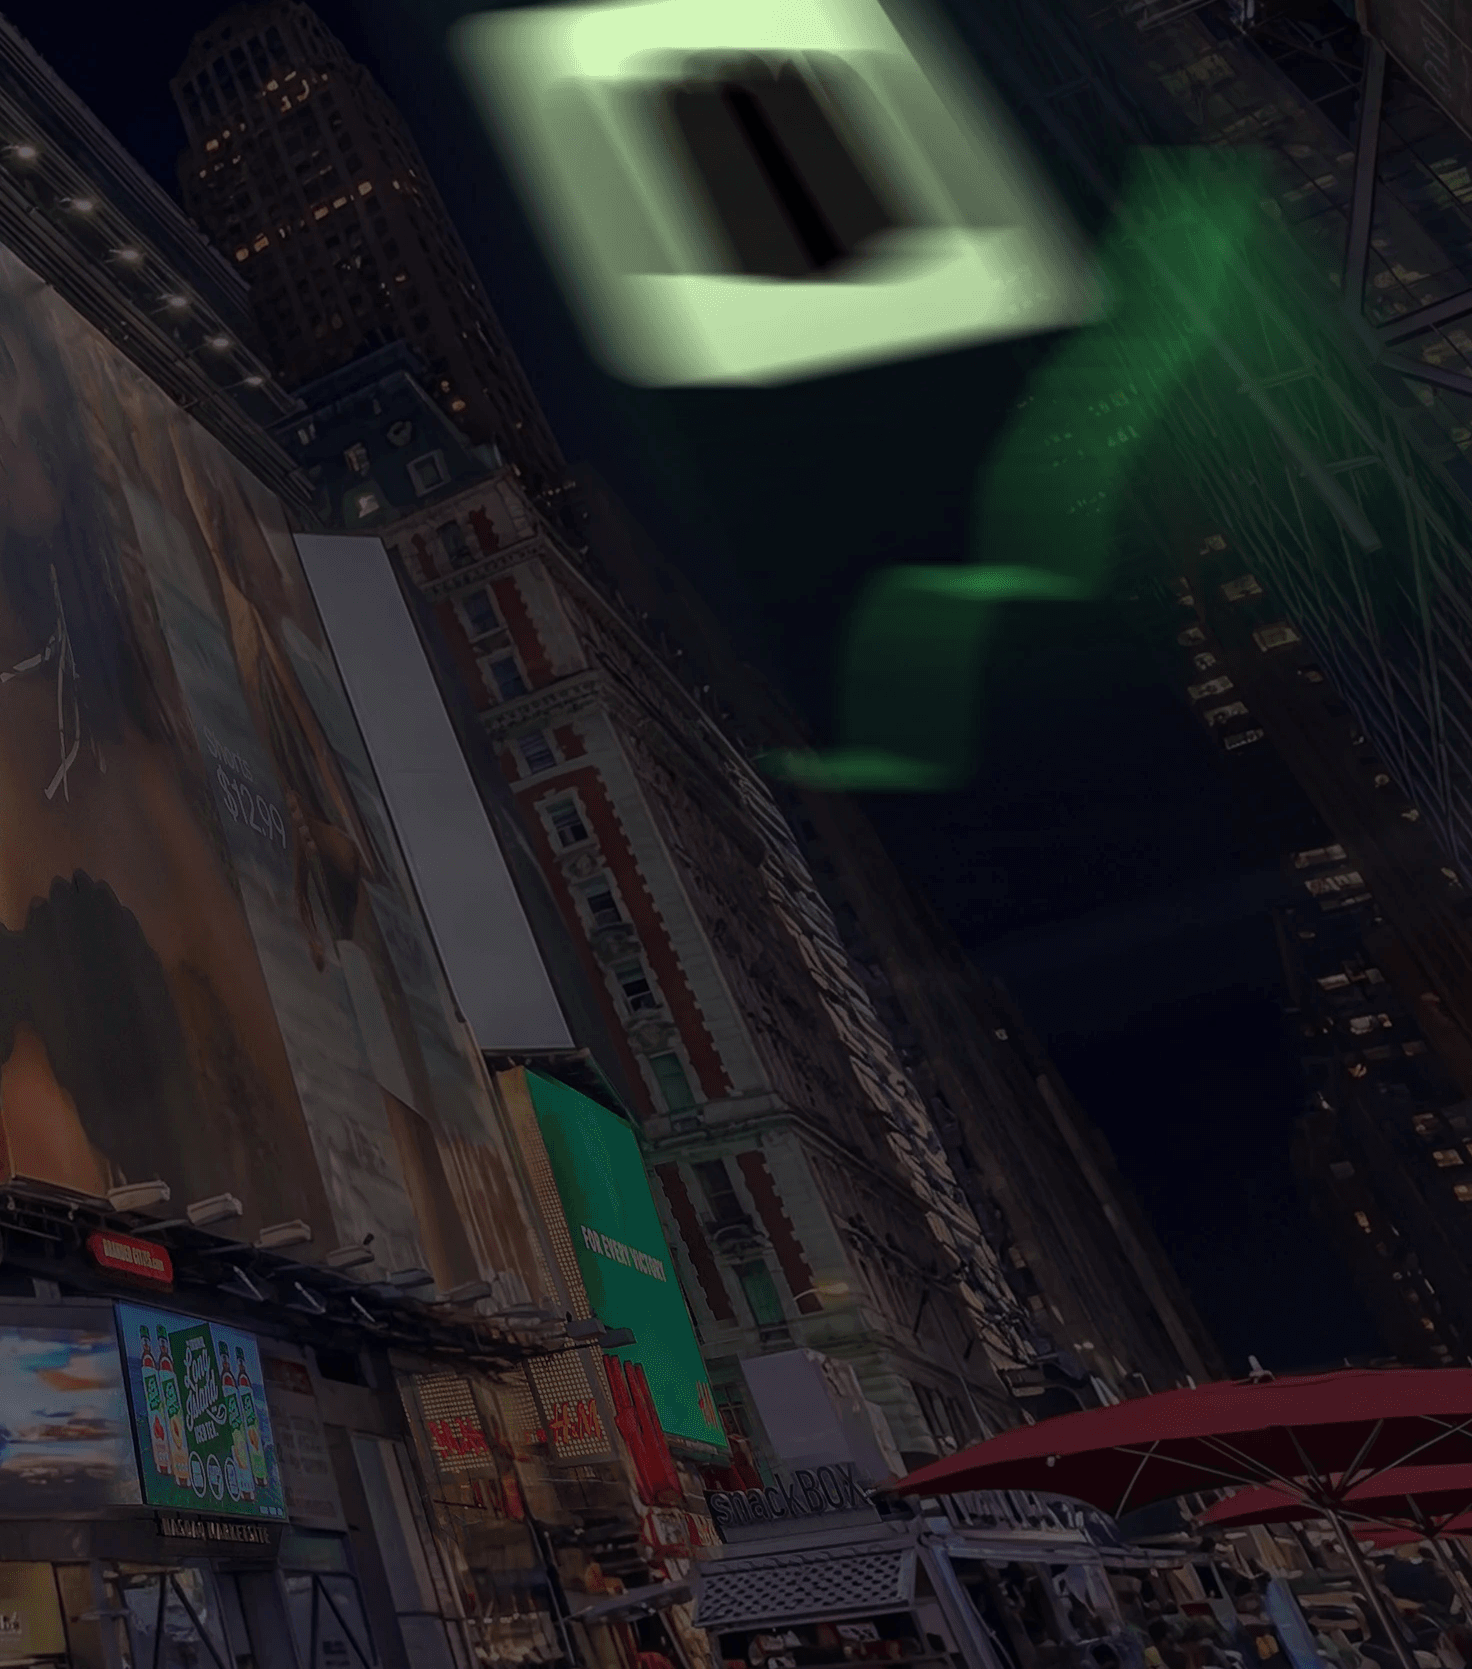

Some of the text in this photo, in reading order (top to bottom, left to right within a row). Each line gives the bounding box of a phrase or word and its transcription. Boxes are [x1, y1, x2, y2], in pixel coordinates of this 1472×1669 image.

[215, 763, 288, 851] $12.99
[580, 1224, 600, 1255] FOR
[601, 1234, 633, 1268] EVERY
[709, 1461, 874, 1526] snackBOX
